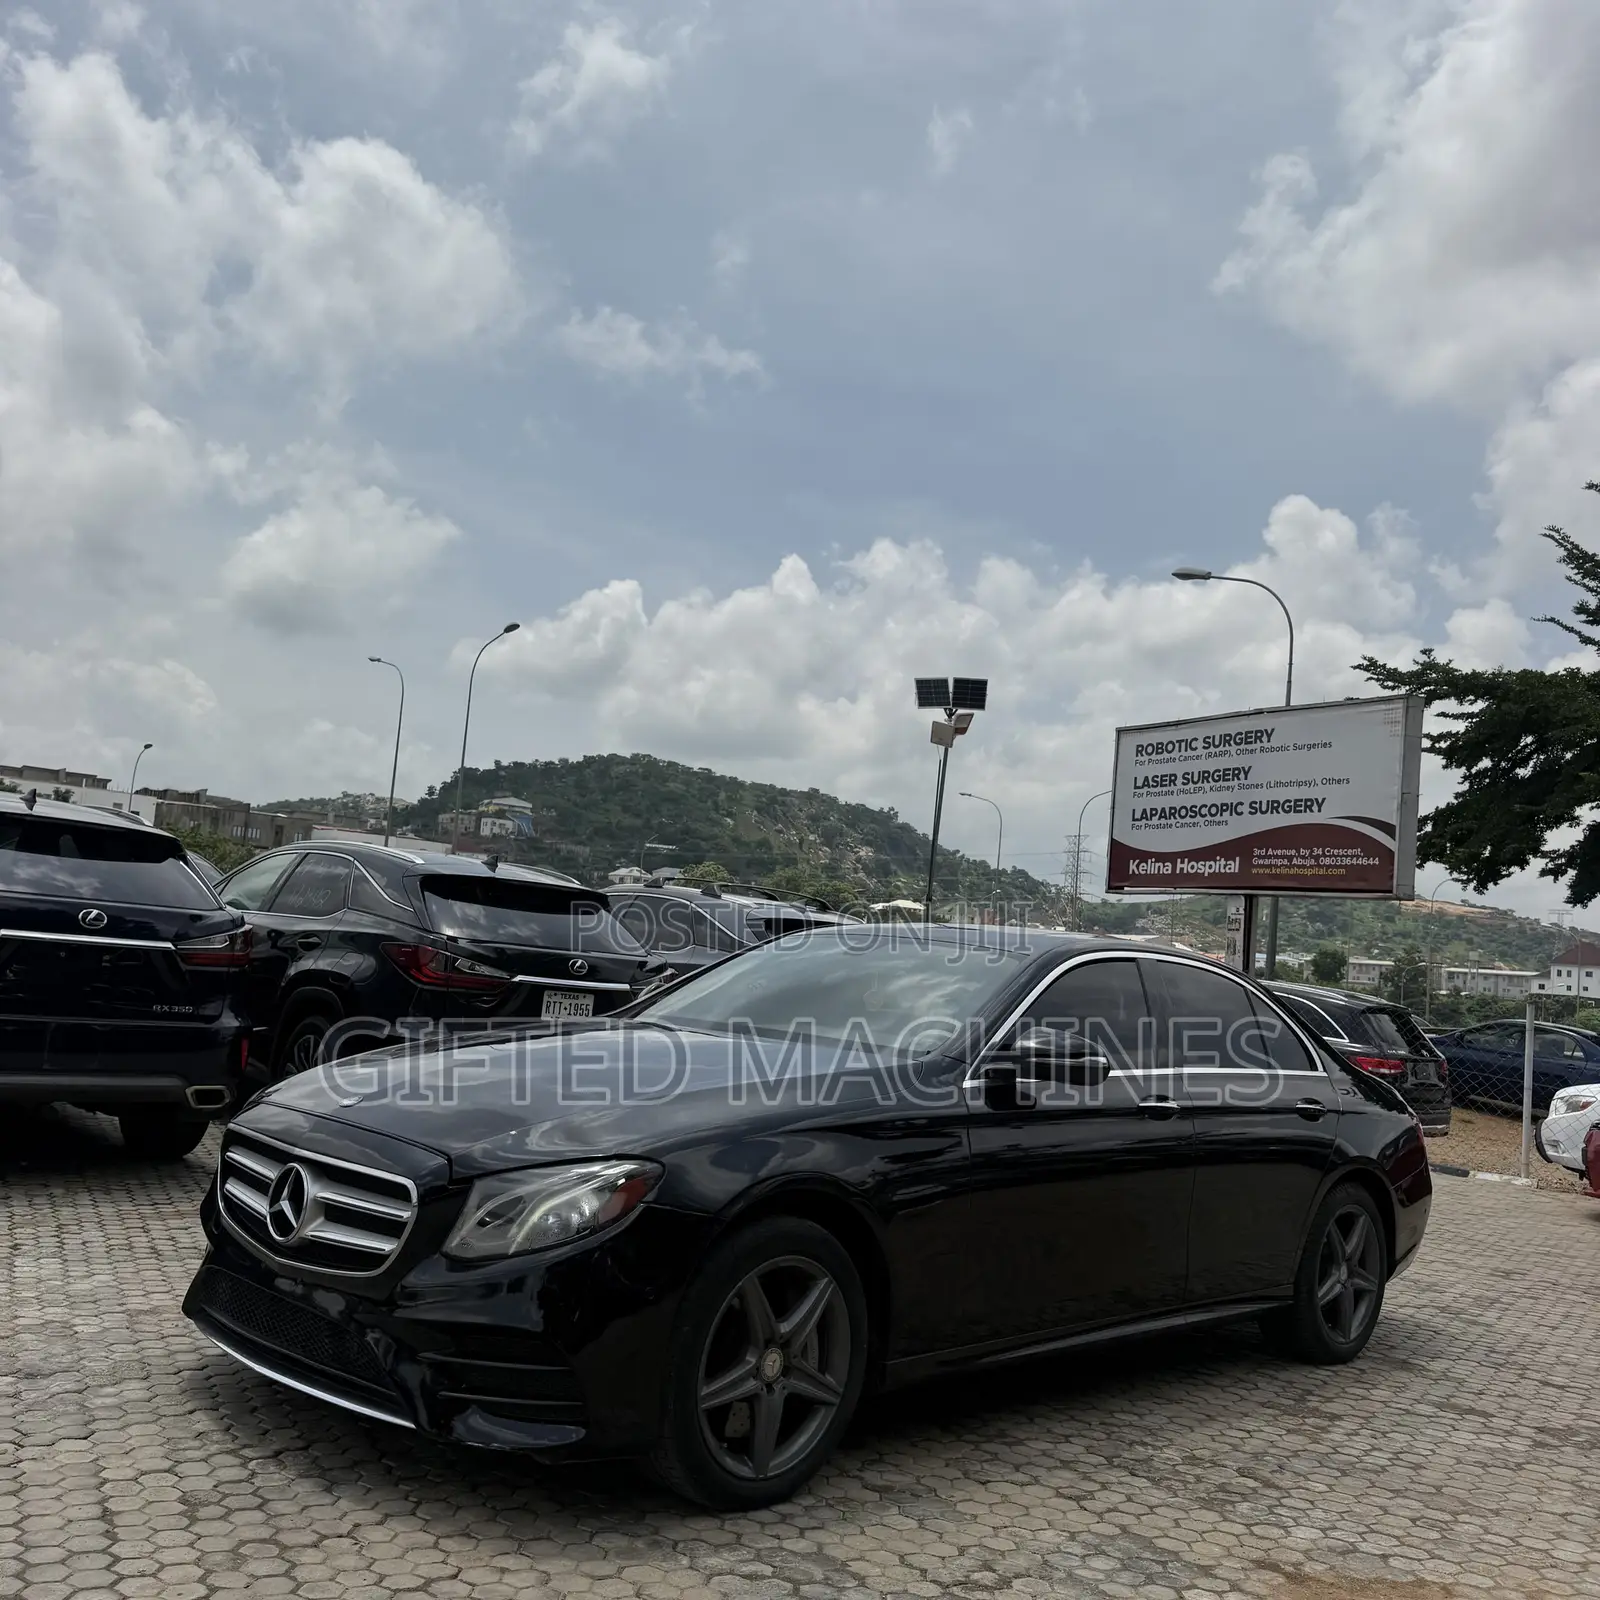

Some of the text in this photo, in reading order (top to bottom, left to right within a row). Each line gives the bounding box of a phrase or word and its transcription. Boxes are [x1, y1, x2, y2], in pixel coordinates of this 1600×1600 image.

[1135, 728, 1275, 757] ROBOTIC SURGERY
[1134, 740, 1333, 767] For Prostate Cancer (RARP), Other Robotic Surgeries
[1133, 766, 1252, 790] LASER SURGERY
[1133, 776, 1350, 799] For Prostate (HoLEP), Kidney Stones (Lithotripsy), Others
[1131, 797, 1327, 822] LAPAROSCOPIC SURGERY
[1131, 819, 1229, 831] For Prostate Cancer, Others
[1252, 847, 1364, 858] 3rd Avenue, by 34 Crescent,
[1252, 857, 1379, 867] Gwarinpa, Abuja. 08033644644
[1129, 856, 1240, 876] Kelina Hospital
[1251, 866, 1346, 876] www.kelinahospital.com
[560, 993, 580, 1001] TEXAS
